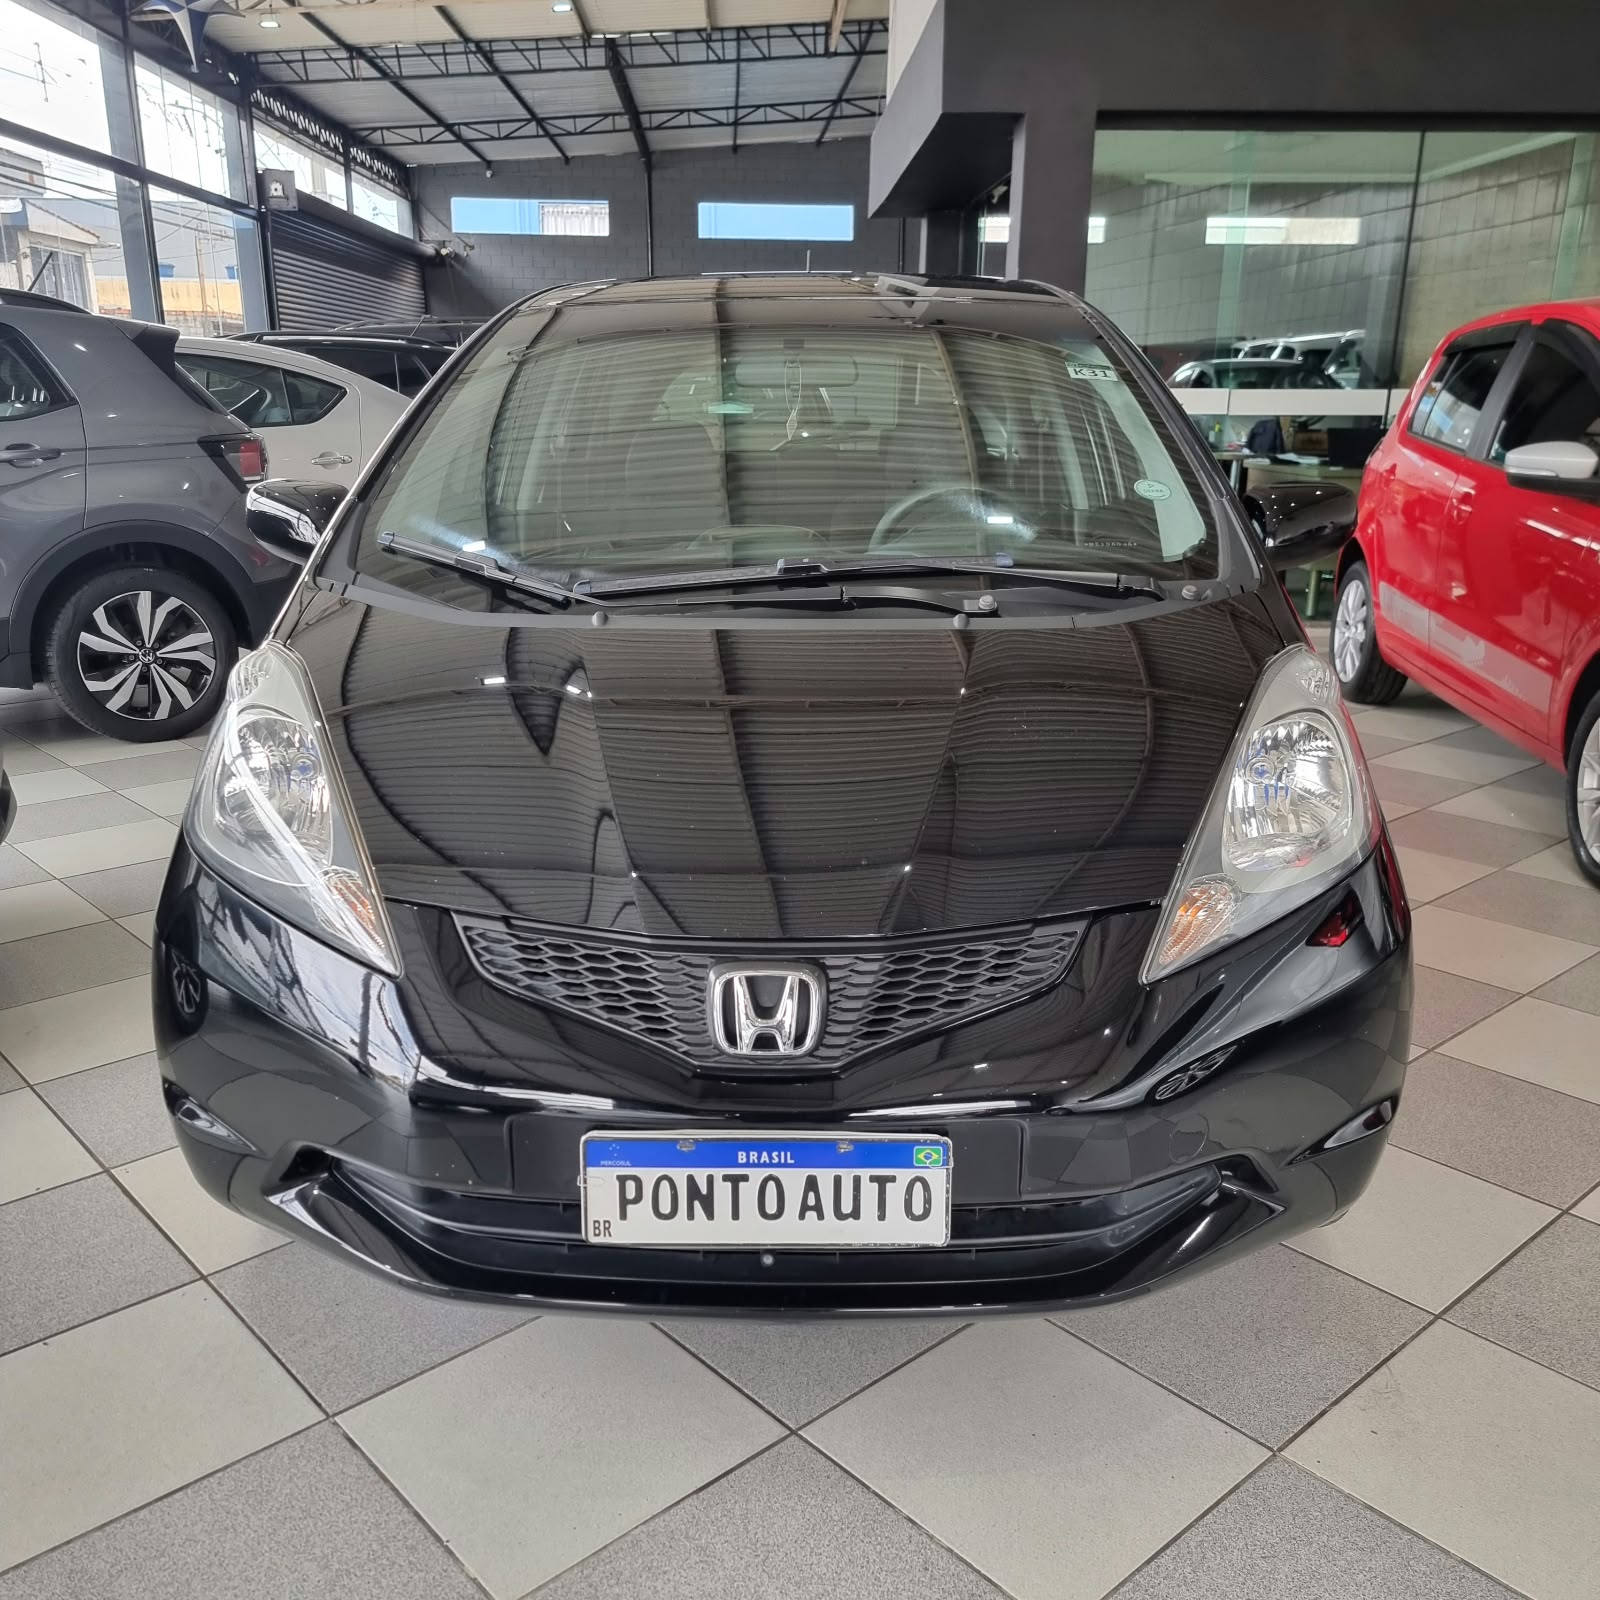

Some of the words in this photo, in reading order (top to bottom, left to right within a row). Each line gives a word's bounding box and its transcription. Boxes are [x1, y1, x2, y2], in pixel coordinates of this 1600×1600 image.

[1073, 368, 1111, 378] K31
[737, 1151, 795, 1164] BRASIL
[593, 1219, 612, 1238] BR
